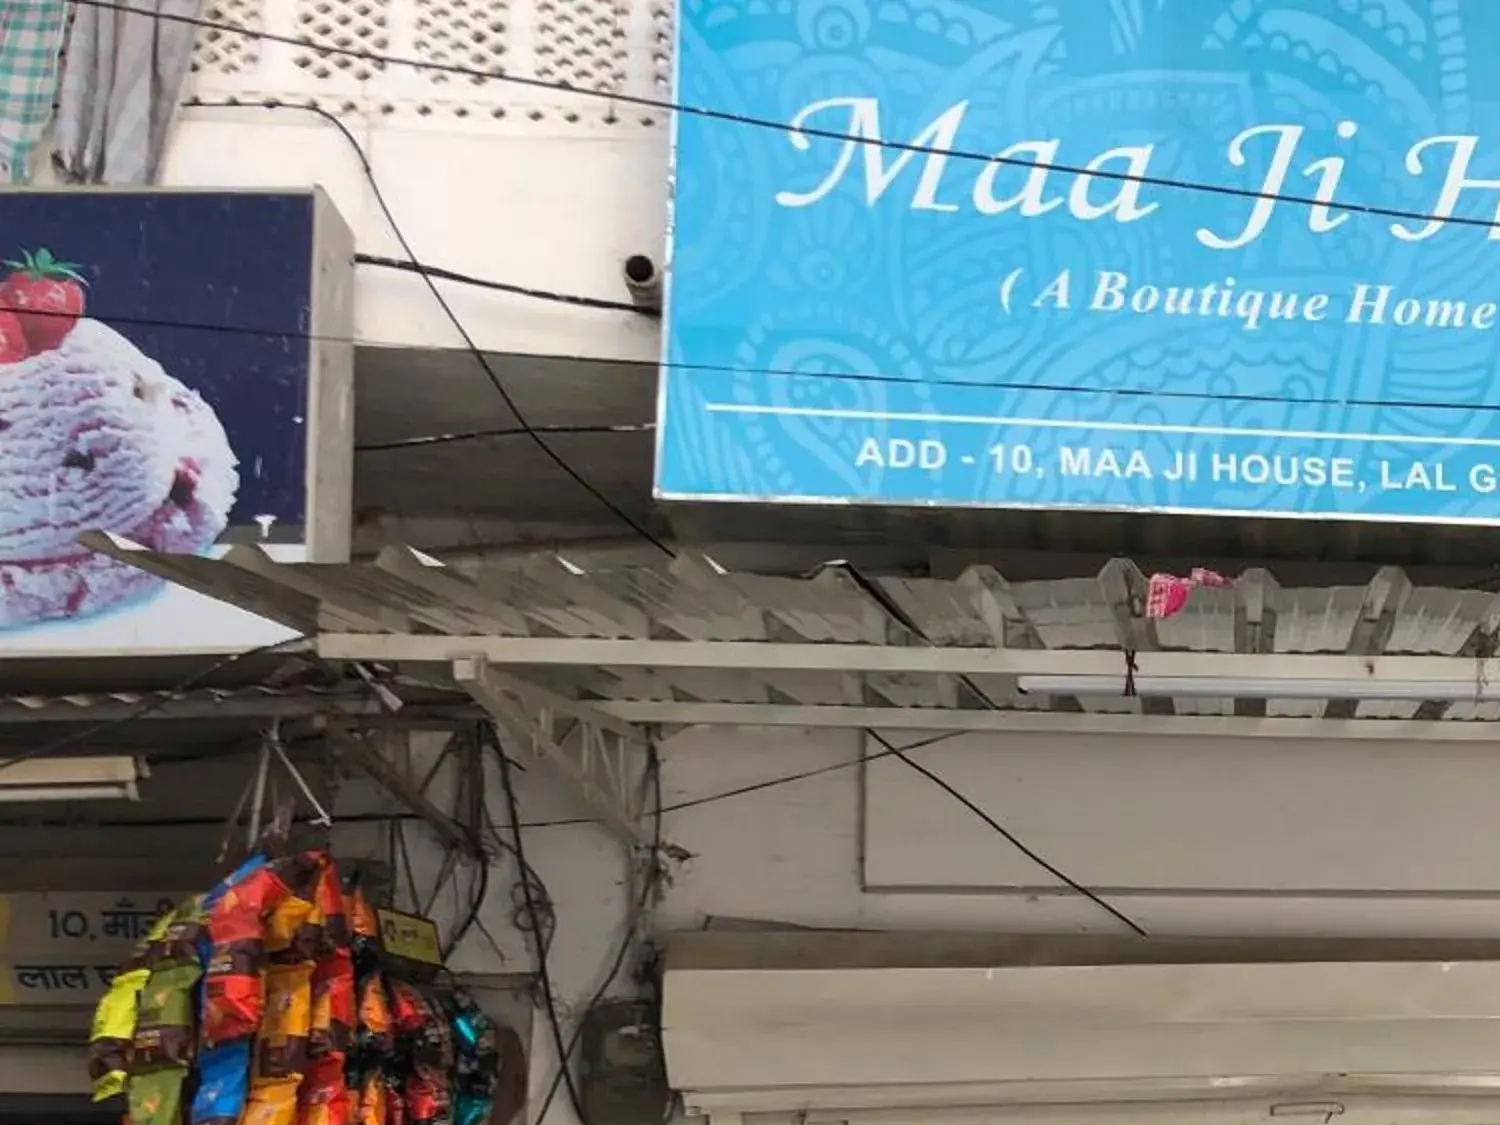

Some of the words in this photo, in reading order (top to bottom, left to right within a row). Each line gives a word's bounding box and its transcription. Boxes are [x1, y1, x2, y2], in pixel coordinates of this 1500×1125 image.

[776, 97, 1160, 222] Maa
[1196, 120, 1357, 250] Ji
[1031, 269, 1071, 308] A
[1090, 270, 1329, 330] Boutique
[1346, 284, 1497, 330] Home
[855, 438, 947, 469] ADD
[989, 444, 1044, 478] 10,
[1059, 447, 1152, 480] MAA
[1164, 452, 1196, 481] JI
[1211, 453, 1366, 492] HOUSE,
[1380, 461, 1455, 491] LAL
[14, 964, 89, 991] लाल
